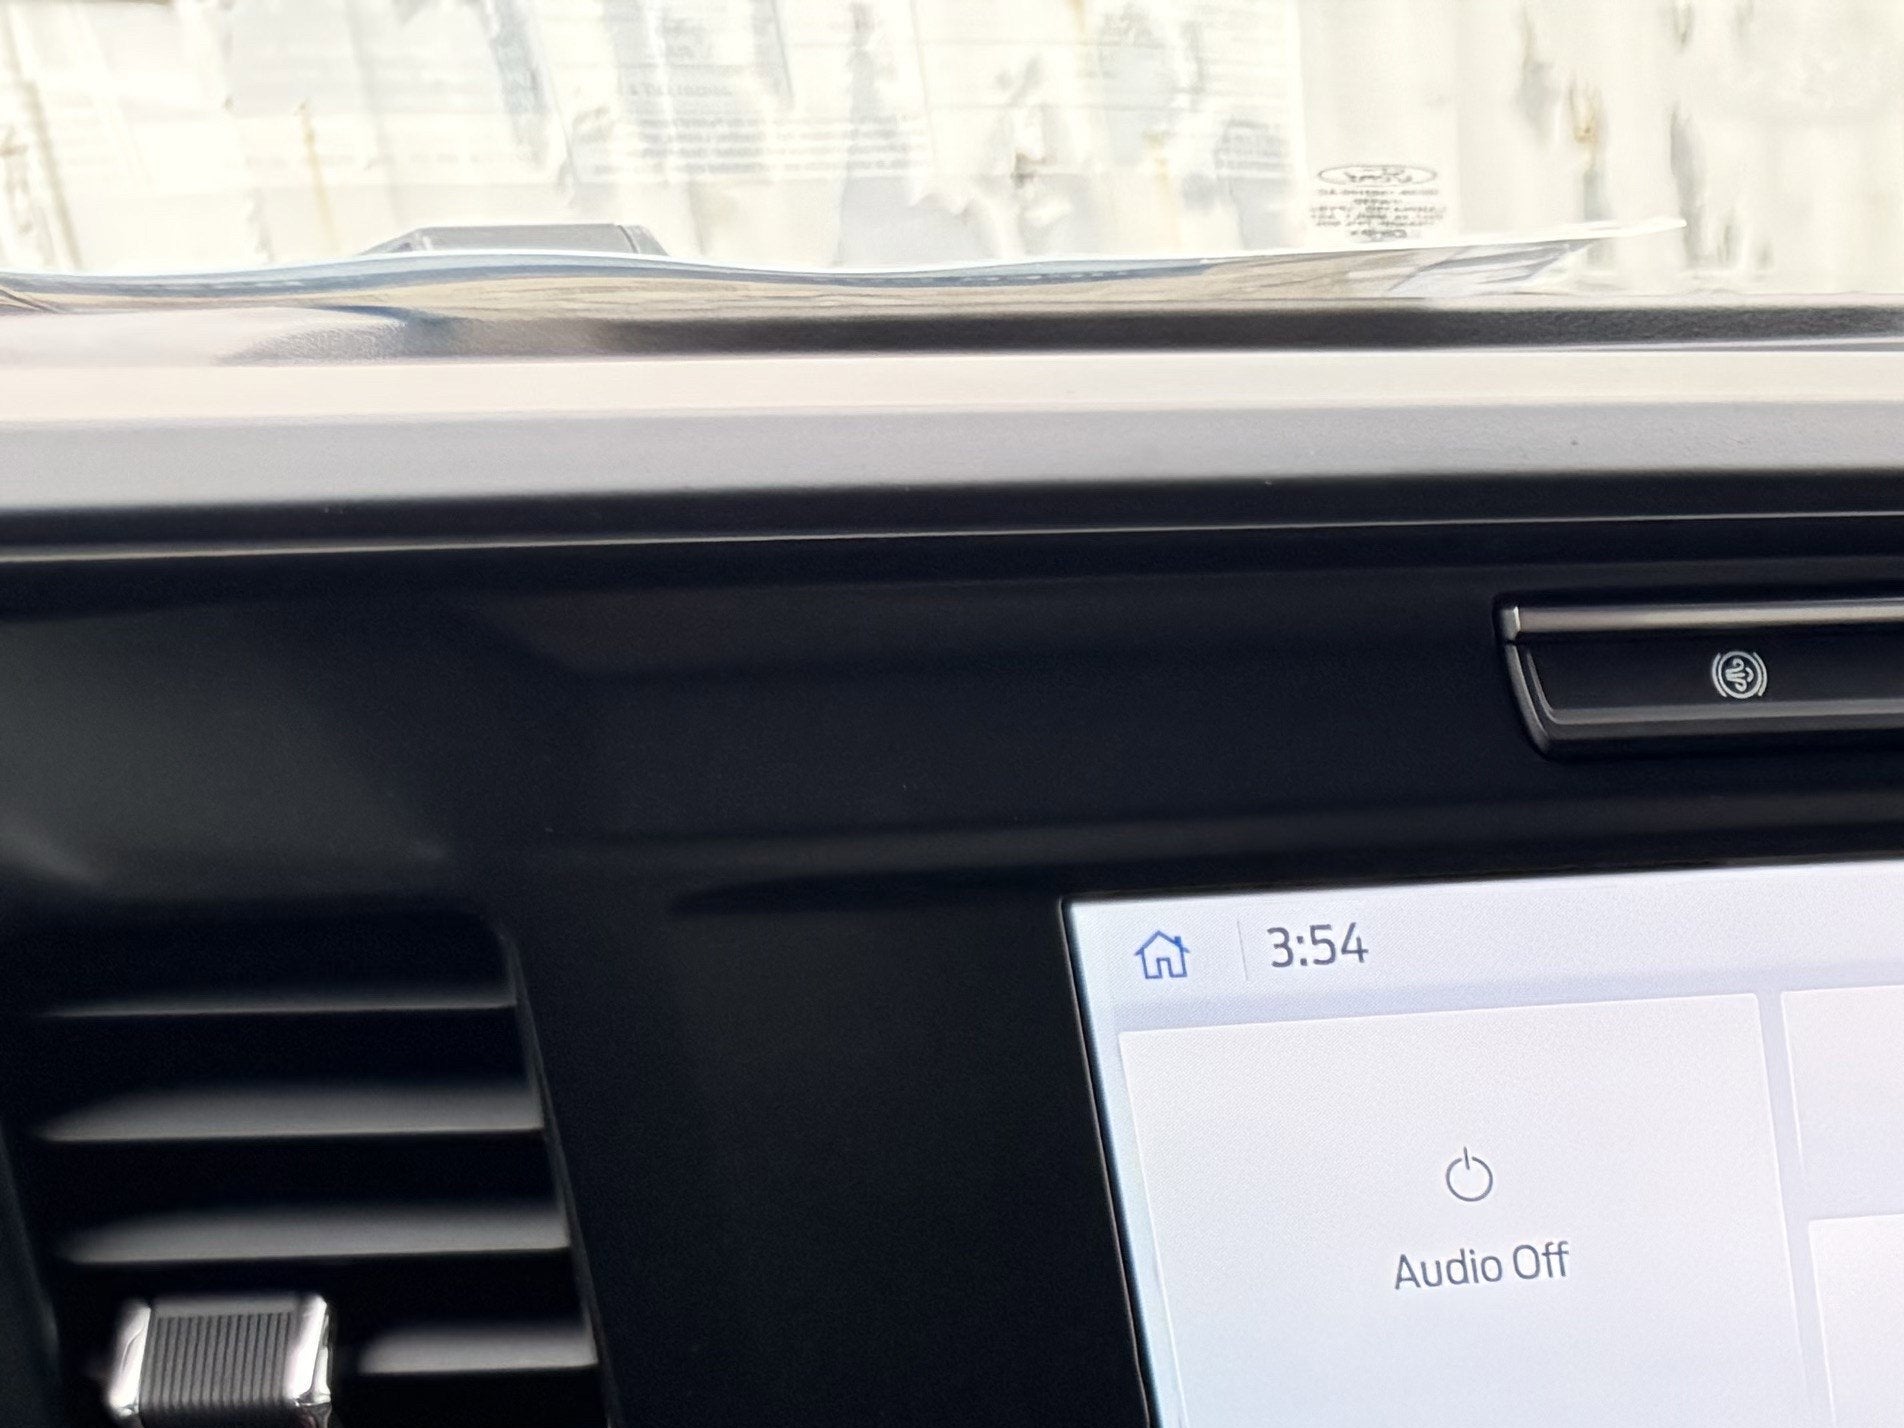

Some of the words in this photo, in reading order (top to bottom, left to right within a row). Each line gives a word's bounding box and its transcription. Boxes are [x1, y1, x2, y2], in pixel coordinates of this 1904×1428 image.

[1266, 921, 1369, 968] 3:54
[1393, 1248, 1503, 1291] Audio
[1512, 1240, 1571, 1281] Off
